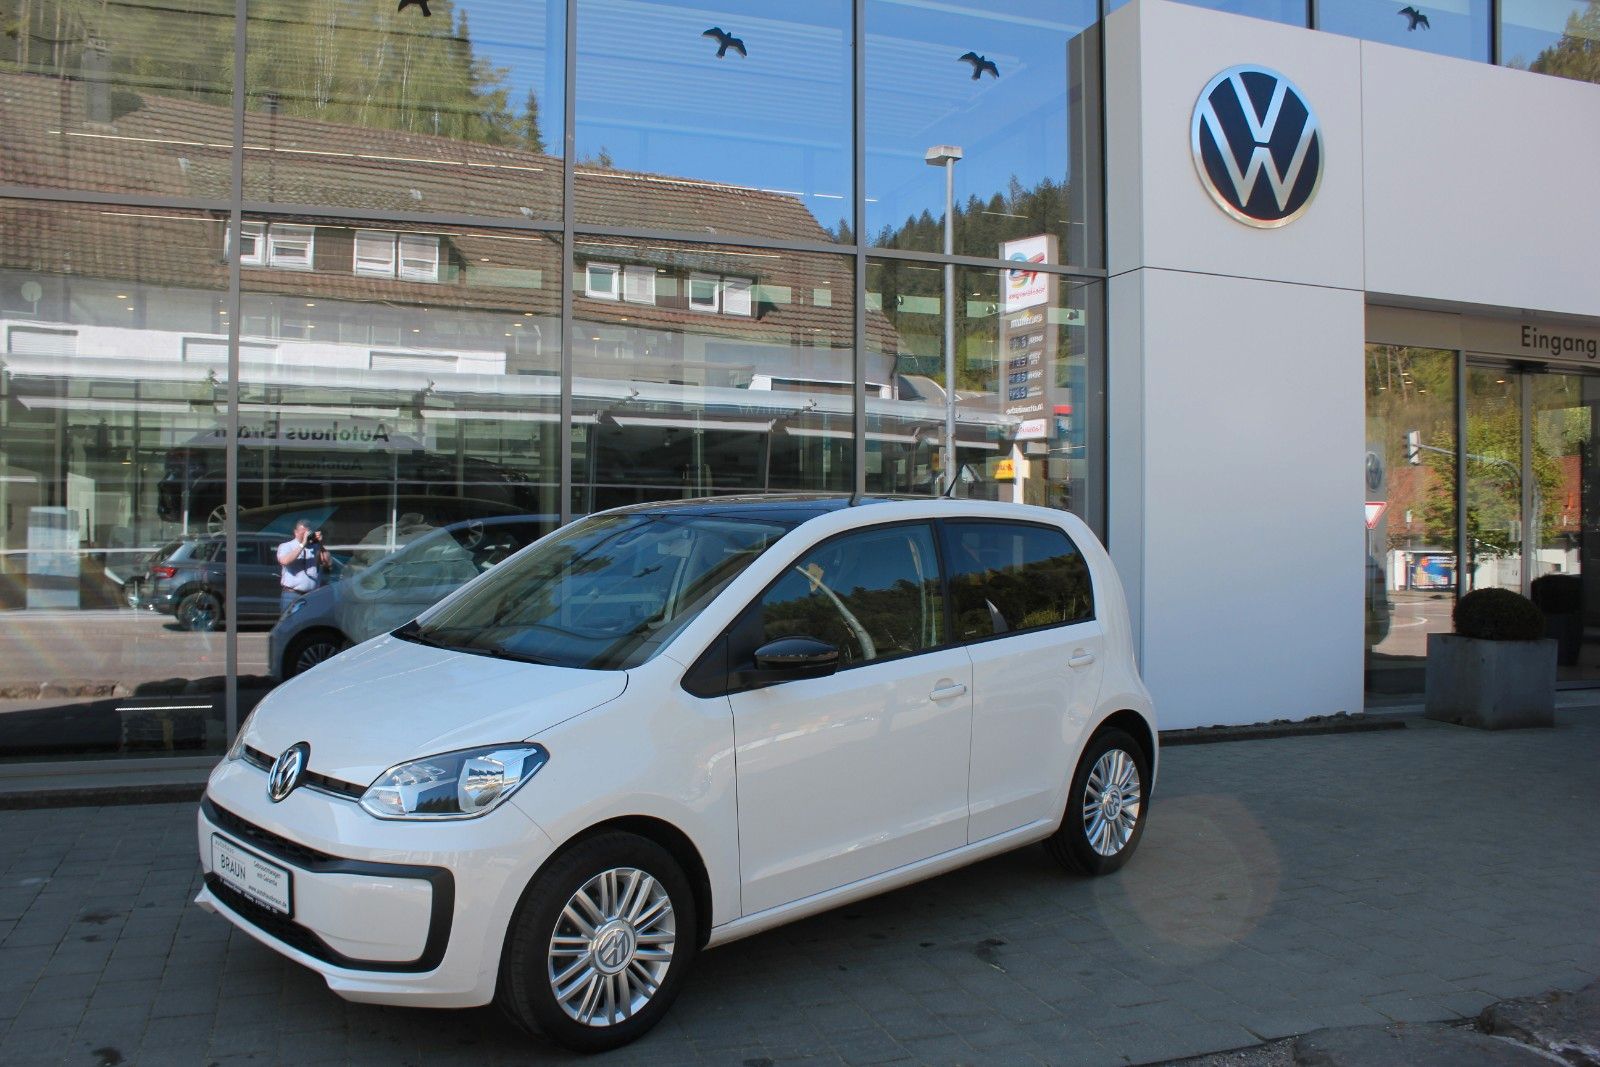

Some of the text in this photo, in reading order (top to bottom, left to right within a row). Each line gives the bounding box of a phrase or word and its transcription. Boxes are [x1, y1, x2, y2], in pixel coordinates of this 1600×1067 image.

[1194, 67, 1321, 222] VW
[1521, 325, 1597, 359] Eingang
[220, 853, 246, 880] BRAUN
